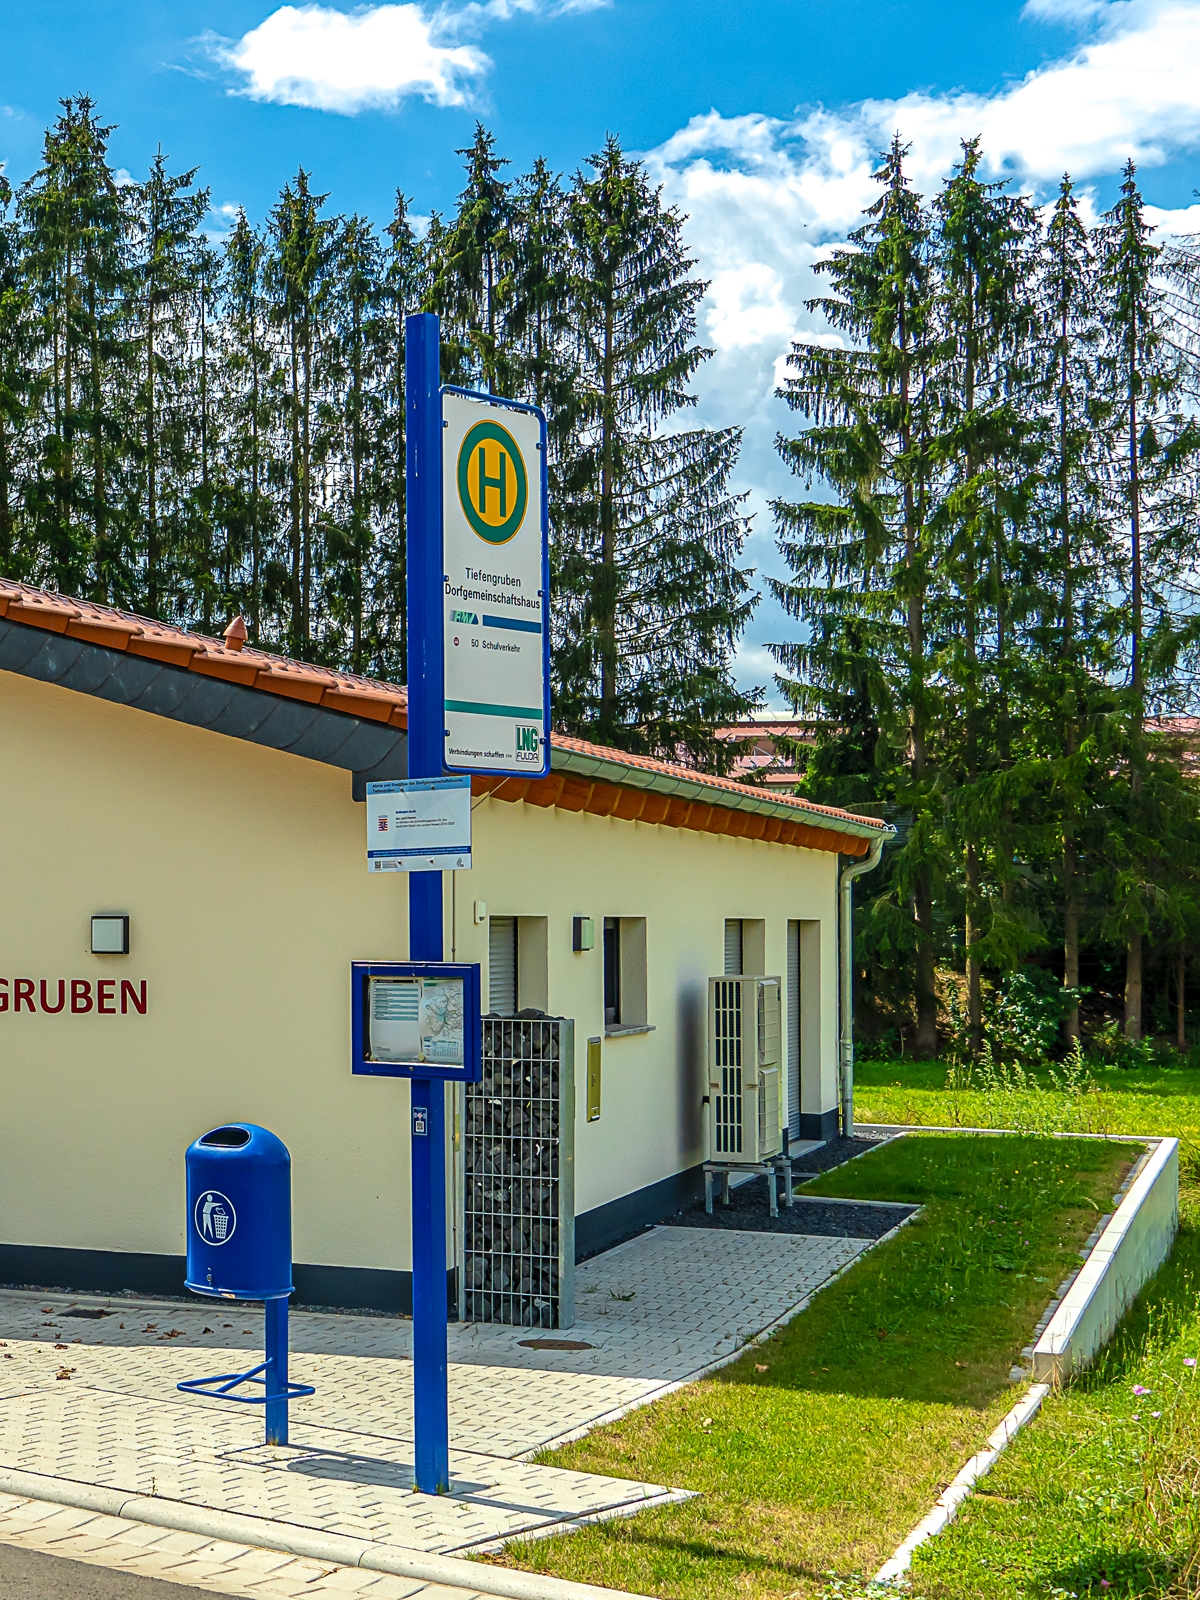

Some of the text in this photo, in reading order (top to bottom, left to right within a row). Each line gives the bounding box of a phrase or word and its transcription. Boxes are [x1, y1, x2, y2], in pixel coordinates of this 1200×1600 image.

[478, 446, 507, 518] H
[465, 567, 521, 587] Tiefengruben
[445, 583, 541, 609] Dorfgemeinschaftshaus
[453, 610, 476, 625] RMV
[471, 638, 521, 653] 50 Schulverkehr
[516, 727, 538, 752] LNG
[448, 748, 504, 759] Verbindungen schaffen
[516, 752, 539, 761] FULDA
